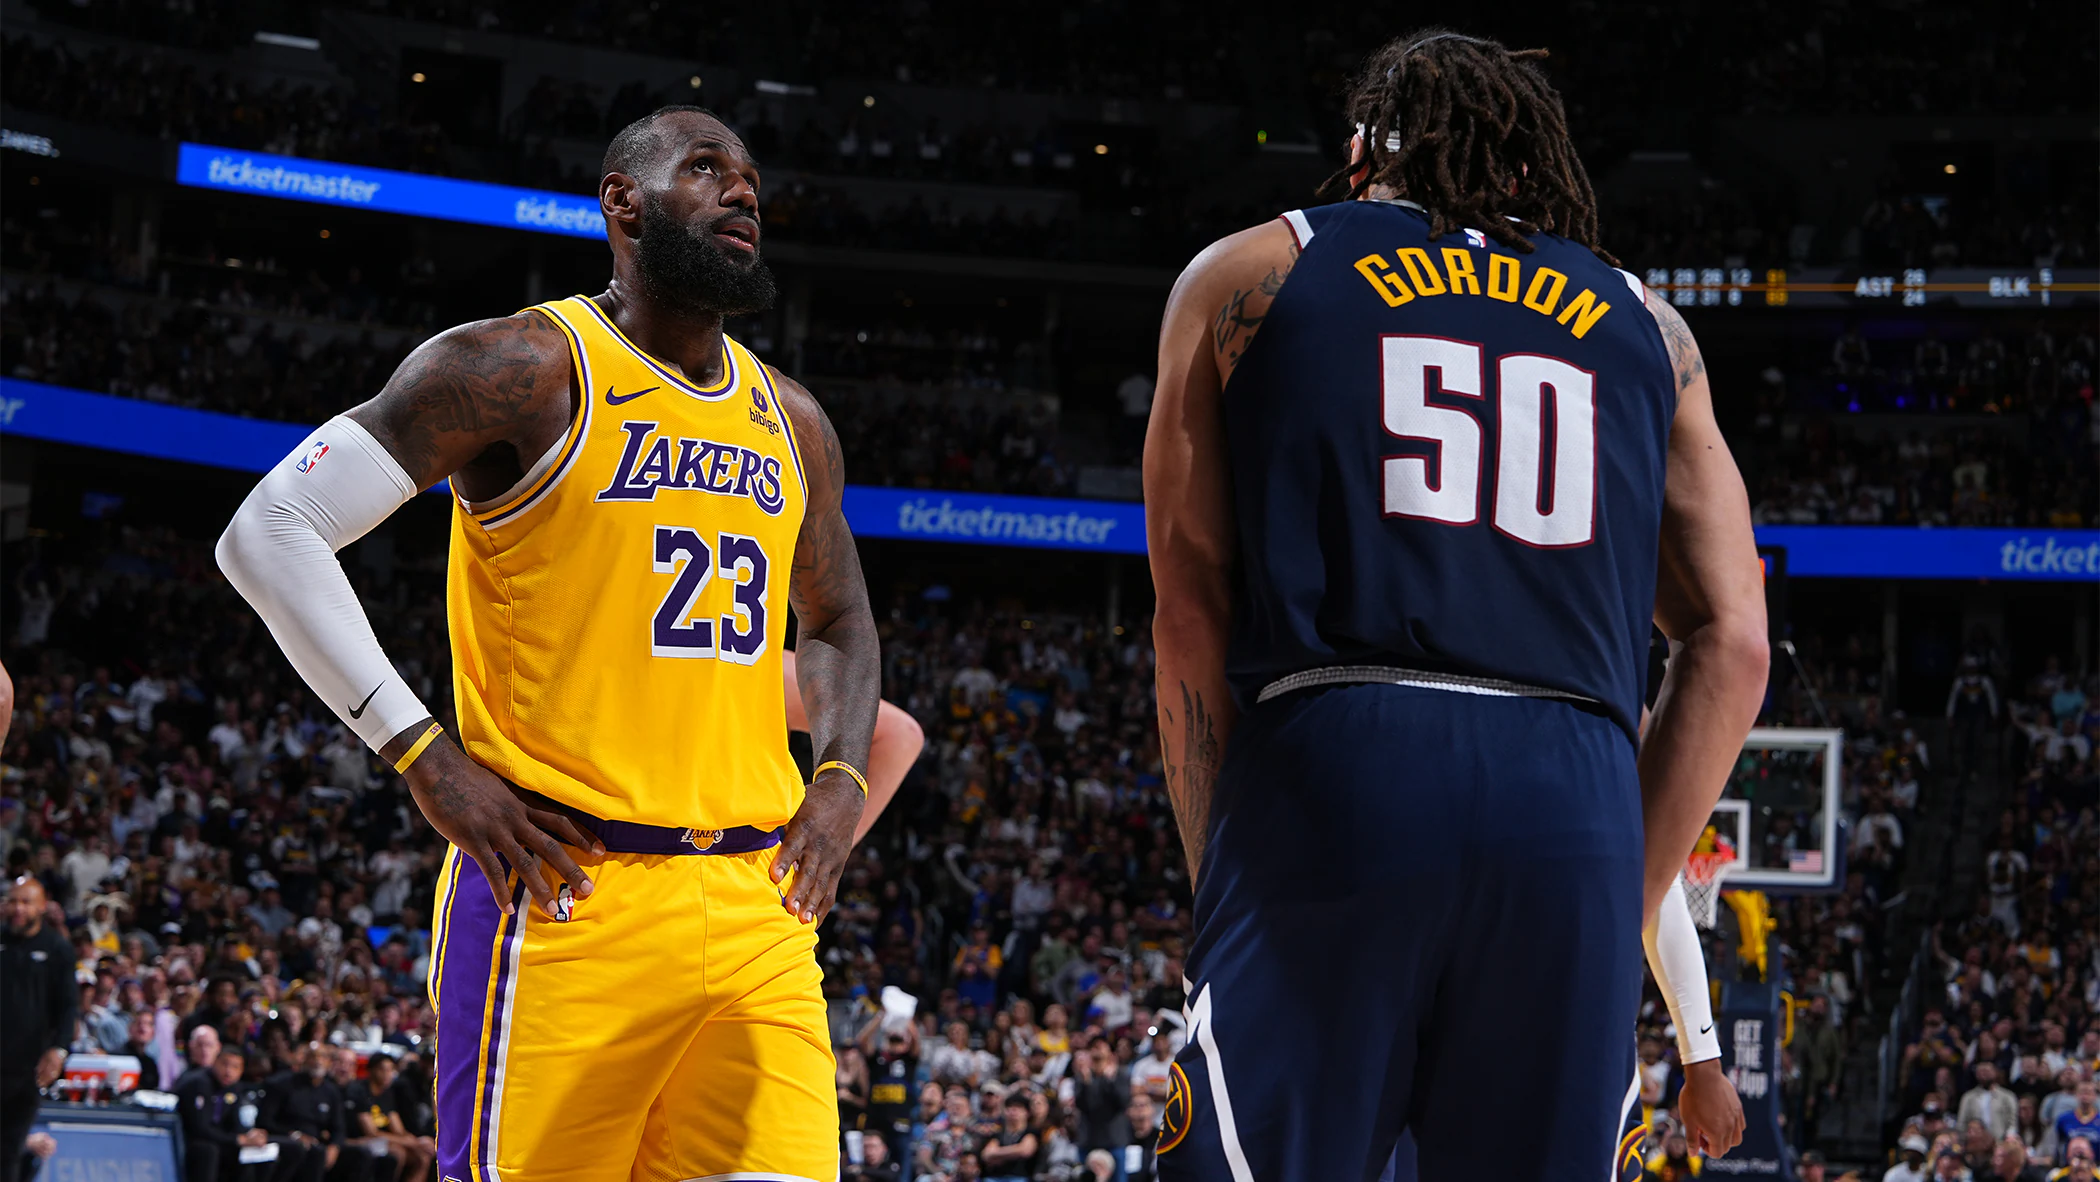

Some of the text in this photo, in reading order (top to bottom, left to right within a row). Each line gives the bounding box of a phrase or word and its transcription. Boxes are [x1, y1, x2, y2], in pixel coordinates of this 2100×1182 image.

[208, 156, 381, 203] ticketmaster
[1353, 246, 1611, 340] GORDON
[1855, 277, 1895, 297] AST
[1989, 277, 2031, 297] BLK
[748, 407, 780, 435] bibigo
[1378, 333, 1597, 550] 50
[593, 420, 786, 518] LAKERS
[898, 498, 1118, 545] ticketmaster
[2000, 536, 2100, 575] ticket
[651, 524, 770, 667] 23
[1733, 1019, 1764, 1043] GET
[1733, 1044, 1763, 1069] THE
[1705, 1158, 1750, 1175] Google
